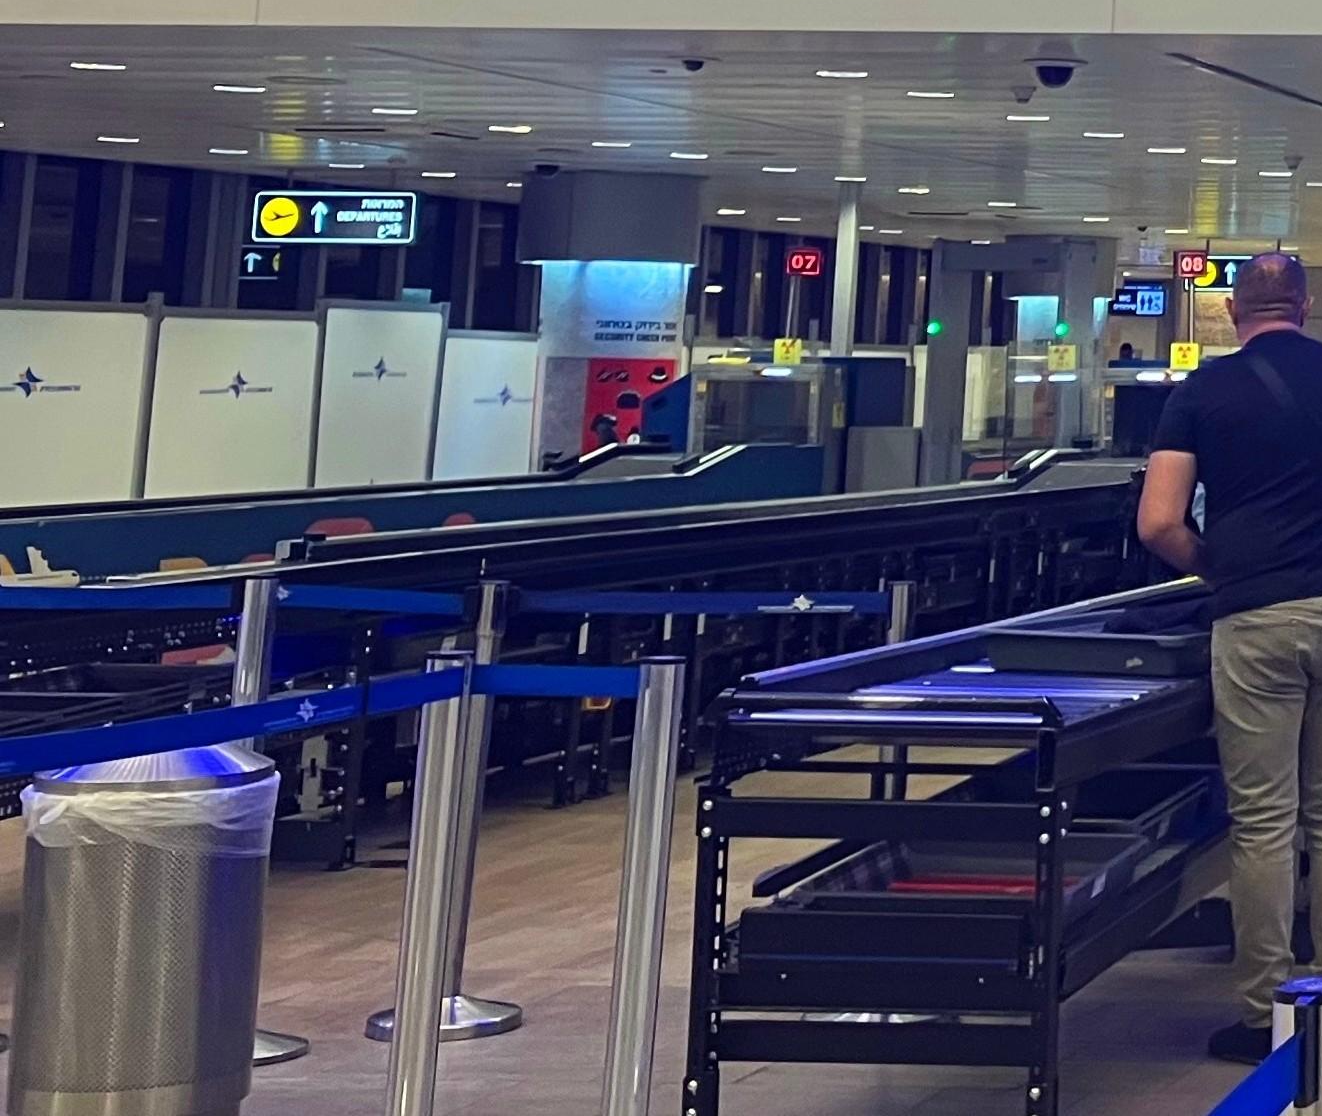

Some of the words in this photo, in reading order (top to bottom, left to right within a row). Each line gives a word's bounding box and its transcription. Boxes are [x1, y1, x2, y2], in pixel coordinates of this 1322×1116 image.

[336, 210, 403, 222] DEPARTURES
[791, 254, 817, 269] 07
[1181, 256, 1204, 272] 08
